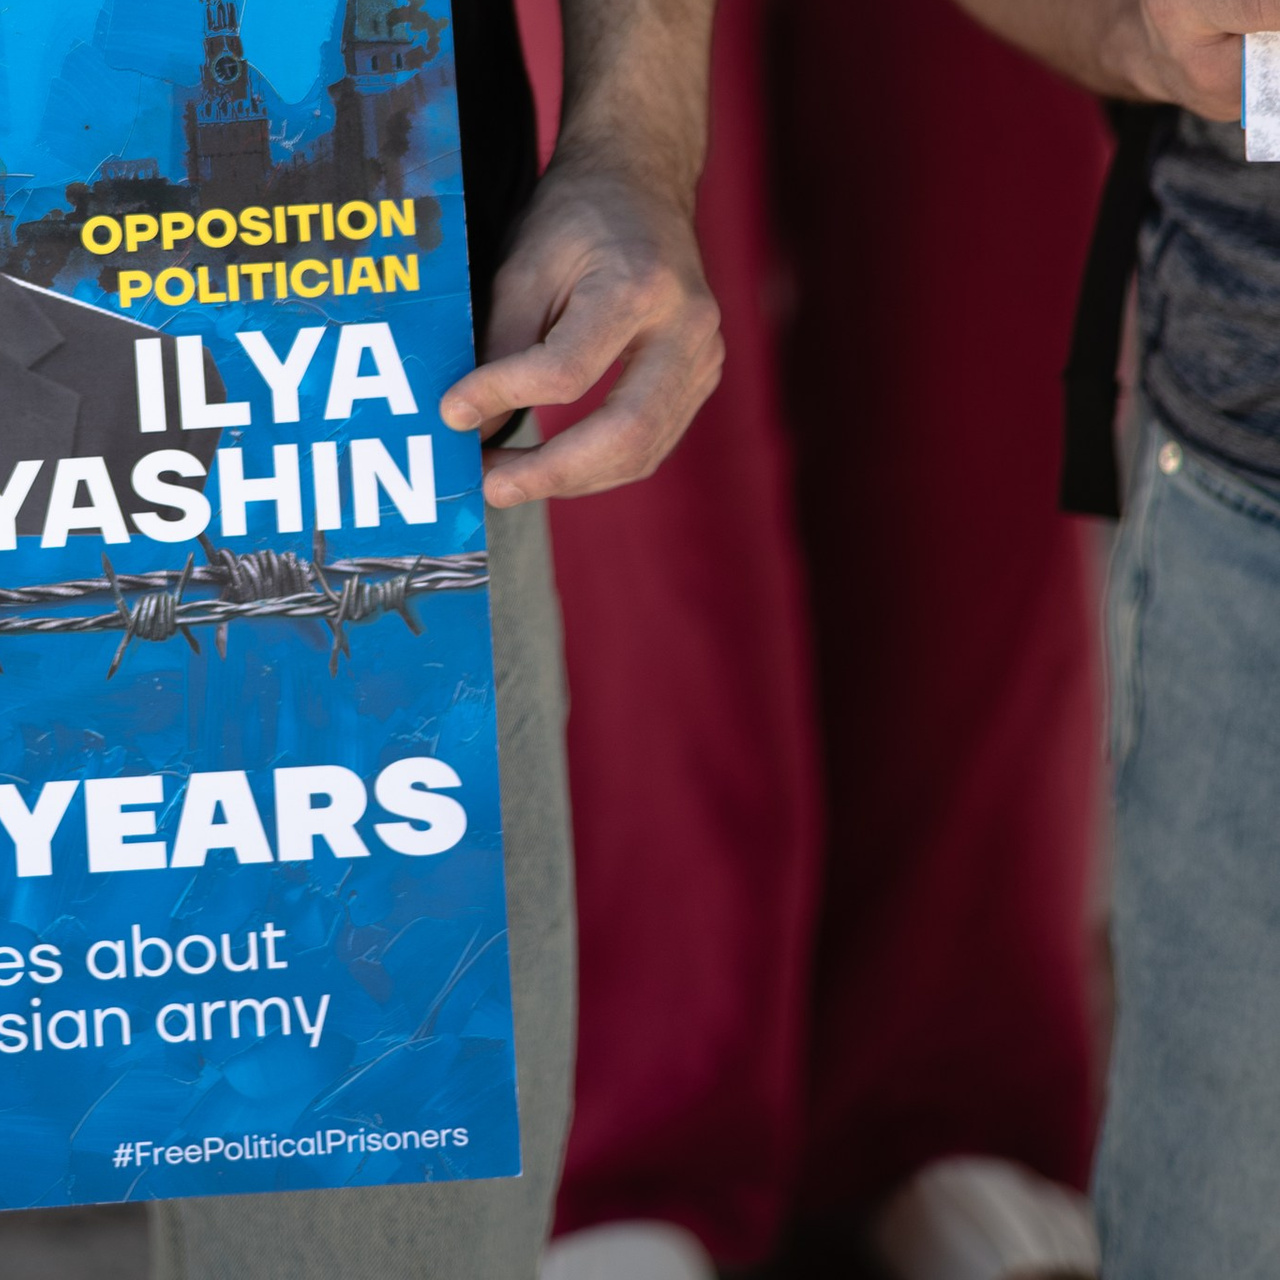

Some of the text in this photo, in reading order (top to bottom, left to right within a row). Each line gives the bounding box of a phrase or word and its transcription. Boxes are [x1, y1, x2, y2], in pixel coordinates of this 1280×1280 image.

[80, 197, 417, 256] OPPOSITION
[117, 253, 421, 309] POLITICIAN
[133, 321, 420, 434] ILYA
[86, 921, 288, 981] about
[155, 994, 332, 1049] army
[112, 1127, 470, 1168] #FreePoliticalPrisoners
